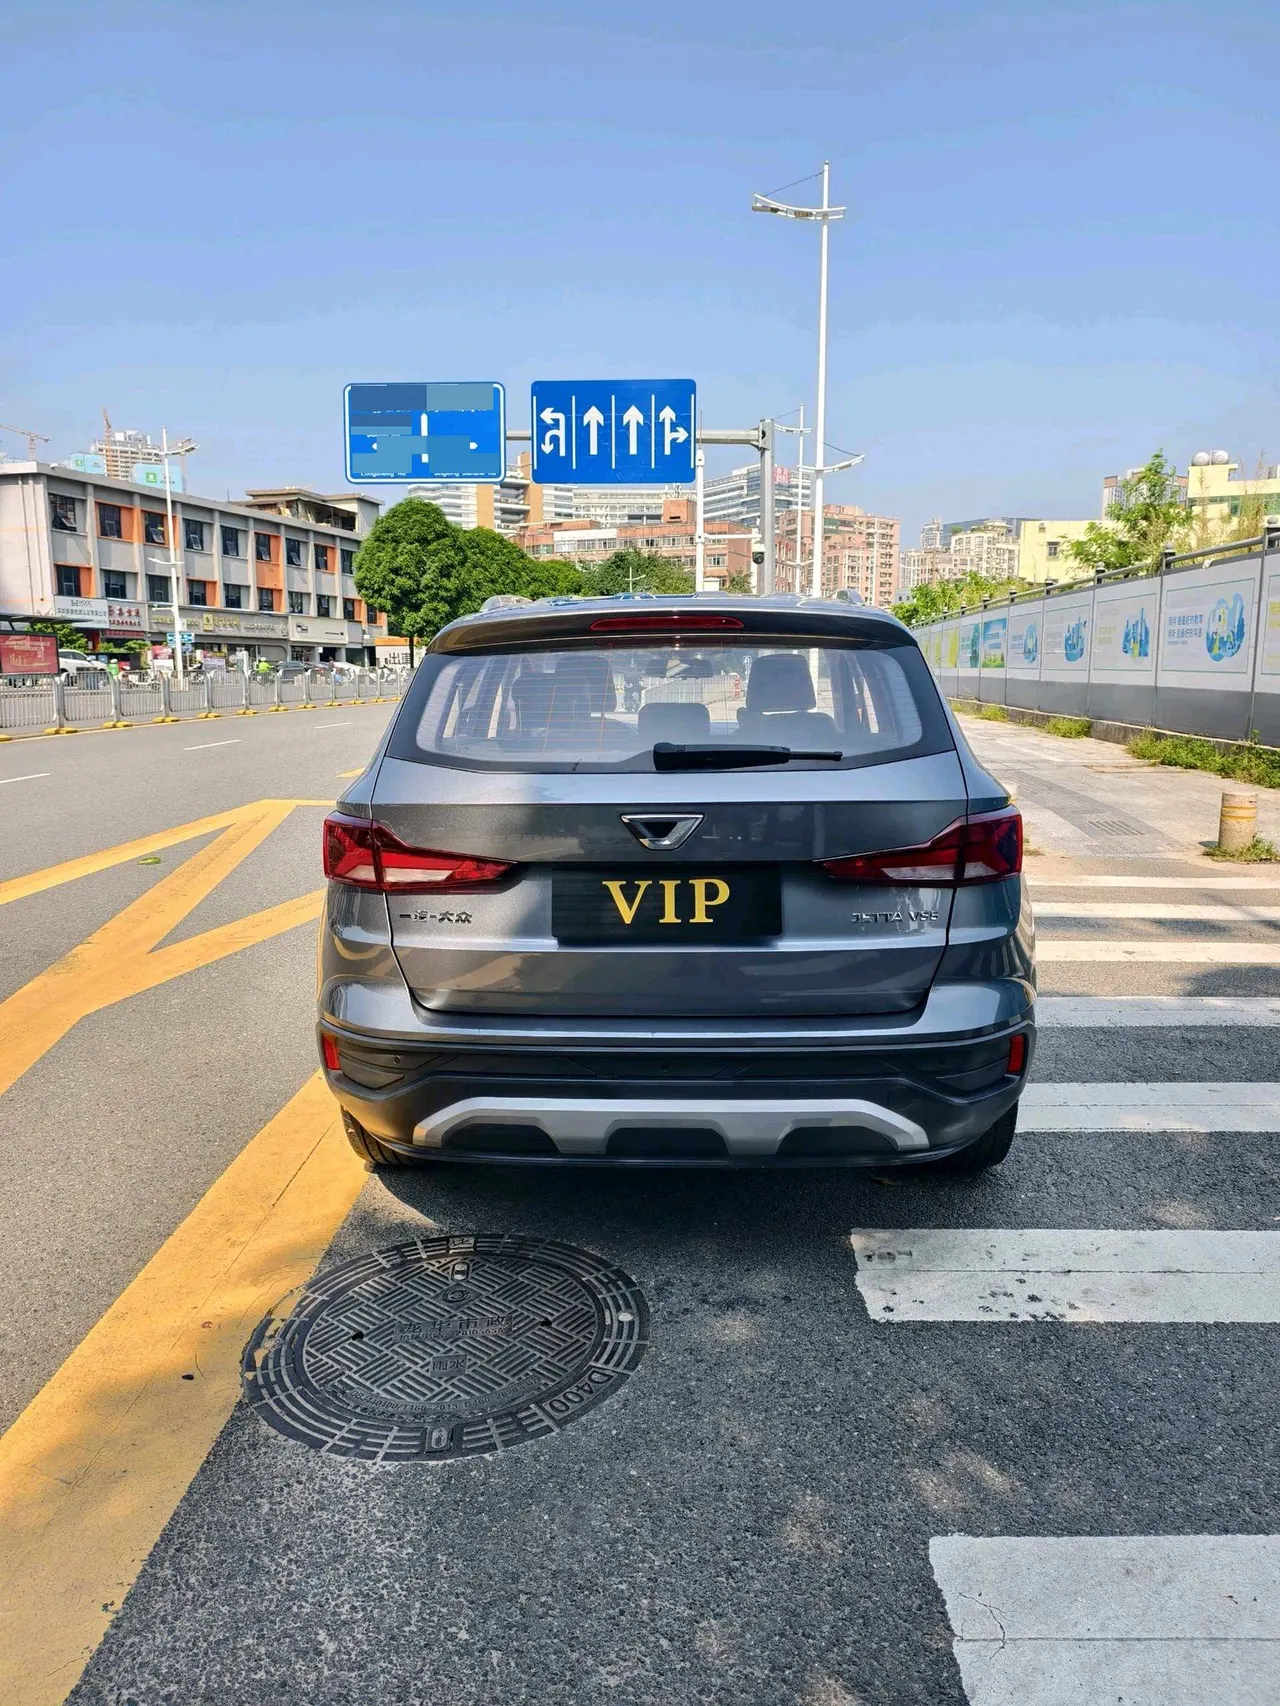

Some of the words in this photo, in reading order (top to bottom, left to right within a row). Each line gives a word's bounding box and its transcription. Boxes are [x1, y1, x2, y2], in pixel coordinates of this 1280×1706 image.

[602, 878, 730, 924] VIP
[851, 911, 903, 923] JETTA
[908, 909, 939, 921] VS5
[432, 1359, 465, 1371] 雨水
[549, 1369, 613, 1413] D400
